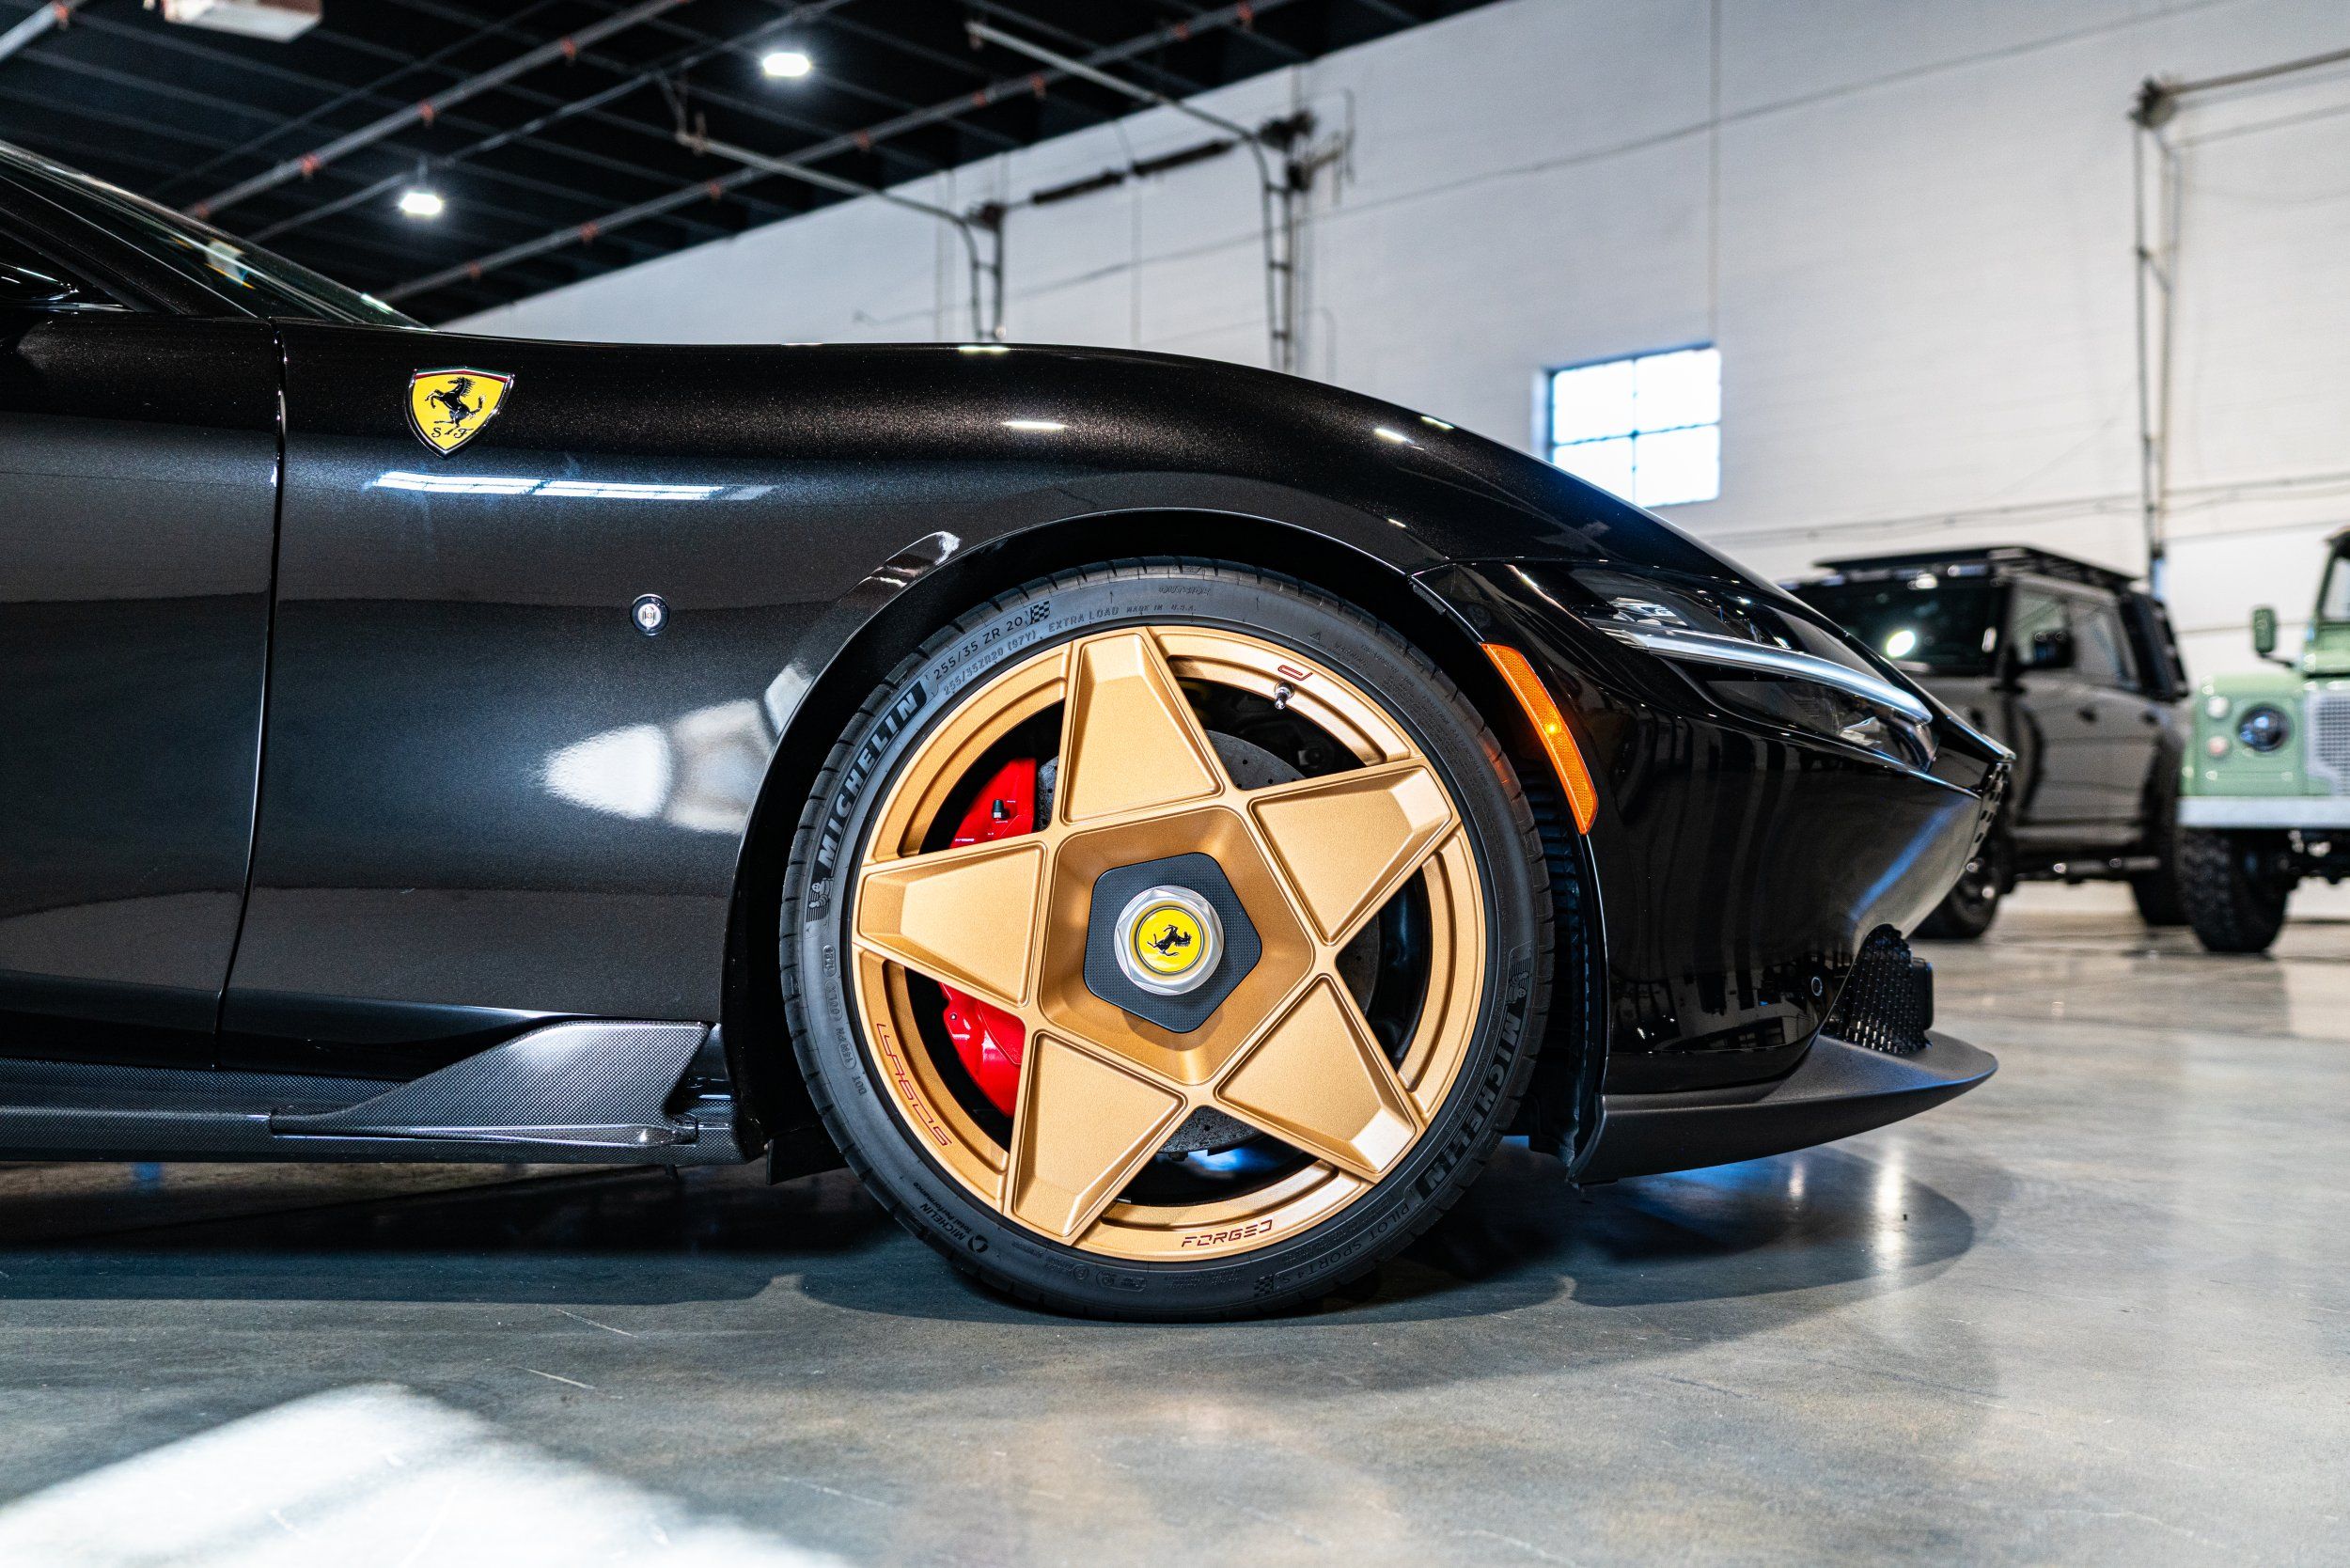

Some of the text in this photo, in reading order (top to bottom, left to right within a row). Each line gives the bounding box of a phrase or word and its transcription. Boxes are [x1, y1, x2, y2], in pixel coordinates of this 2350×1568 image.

[431, 427, 442, 438] S
[1048, 615, 1084, 633] EXTRA
[1089, 606, 1119, 619] LOAD
[933, 616, 1023, 680] 255/35 ZR 20
[944, 646, 1004, 696] 255/35ZR20
[817, 691, 918, 870] MICHELIN
[1425, 1012, 1521, 1189] MICHELIN
[913, 1182, 972, 1234] Total Performance
[920, 1203, 966, 1240] MICHELIN
[1370, 1202, 1410, 1242] PILOT
[1182, 1218, 1273, 1247] FORGED
[1308, 1242, 1362, 1276] SPORT
